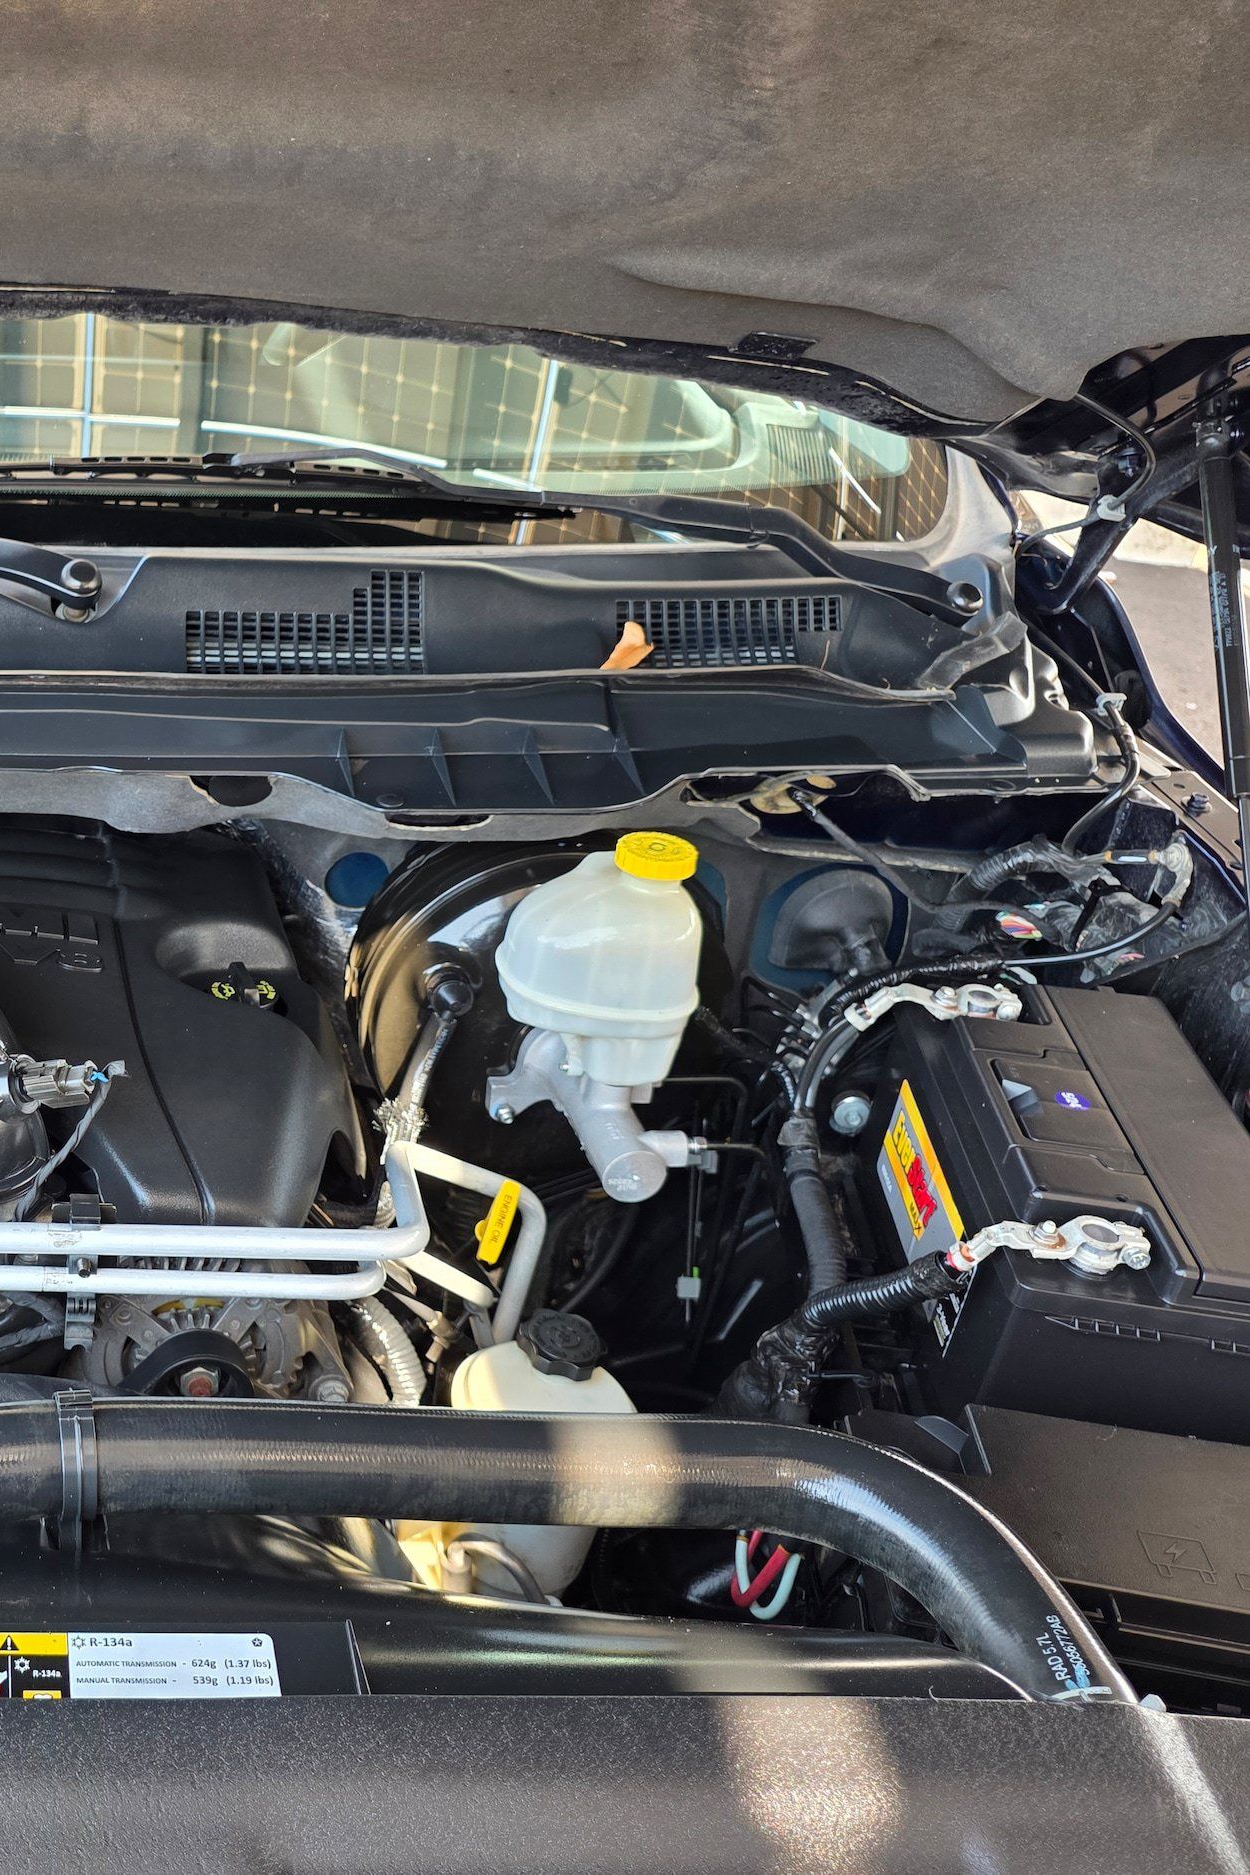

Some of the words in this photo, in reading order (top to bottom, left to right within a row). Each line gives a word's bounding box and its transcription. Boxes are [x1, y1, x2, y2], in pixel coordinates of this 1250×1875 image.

[892, 1109, 938, 1228] EverStart
[494, 1194, 512, 1229] ENGINE
[490, 1229, 500, 1243] OIL
[89, 1637, 132, 1648] R-134a
[1036, 1632, 1057, 1655] 5.7L
[76, 1660, 120, 1668] AUTOMATIC
[121, 1660, 177, 1668] TRANSMISSION
[191, 1659, 217, 1670] 624g
[224, 1658, 250, 1670] (1.37
[252, 1658, 272, 1670] lbs)
[1047, 1656, 1071, 1681] RAD
[32, 1669, 61, 1678] R-134a
[104, 1677, 167, 1685] TRANSMISSION
[193, 1675, 219, 1687] 539g
[226, 1675, 251, 1687] (1.19
[253, 1675, 274, 1687] lbs)
